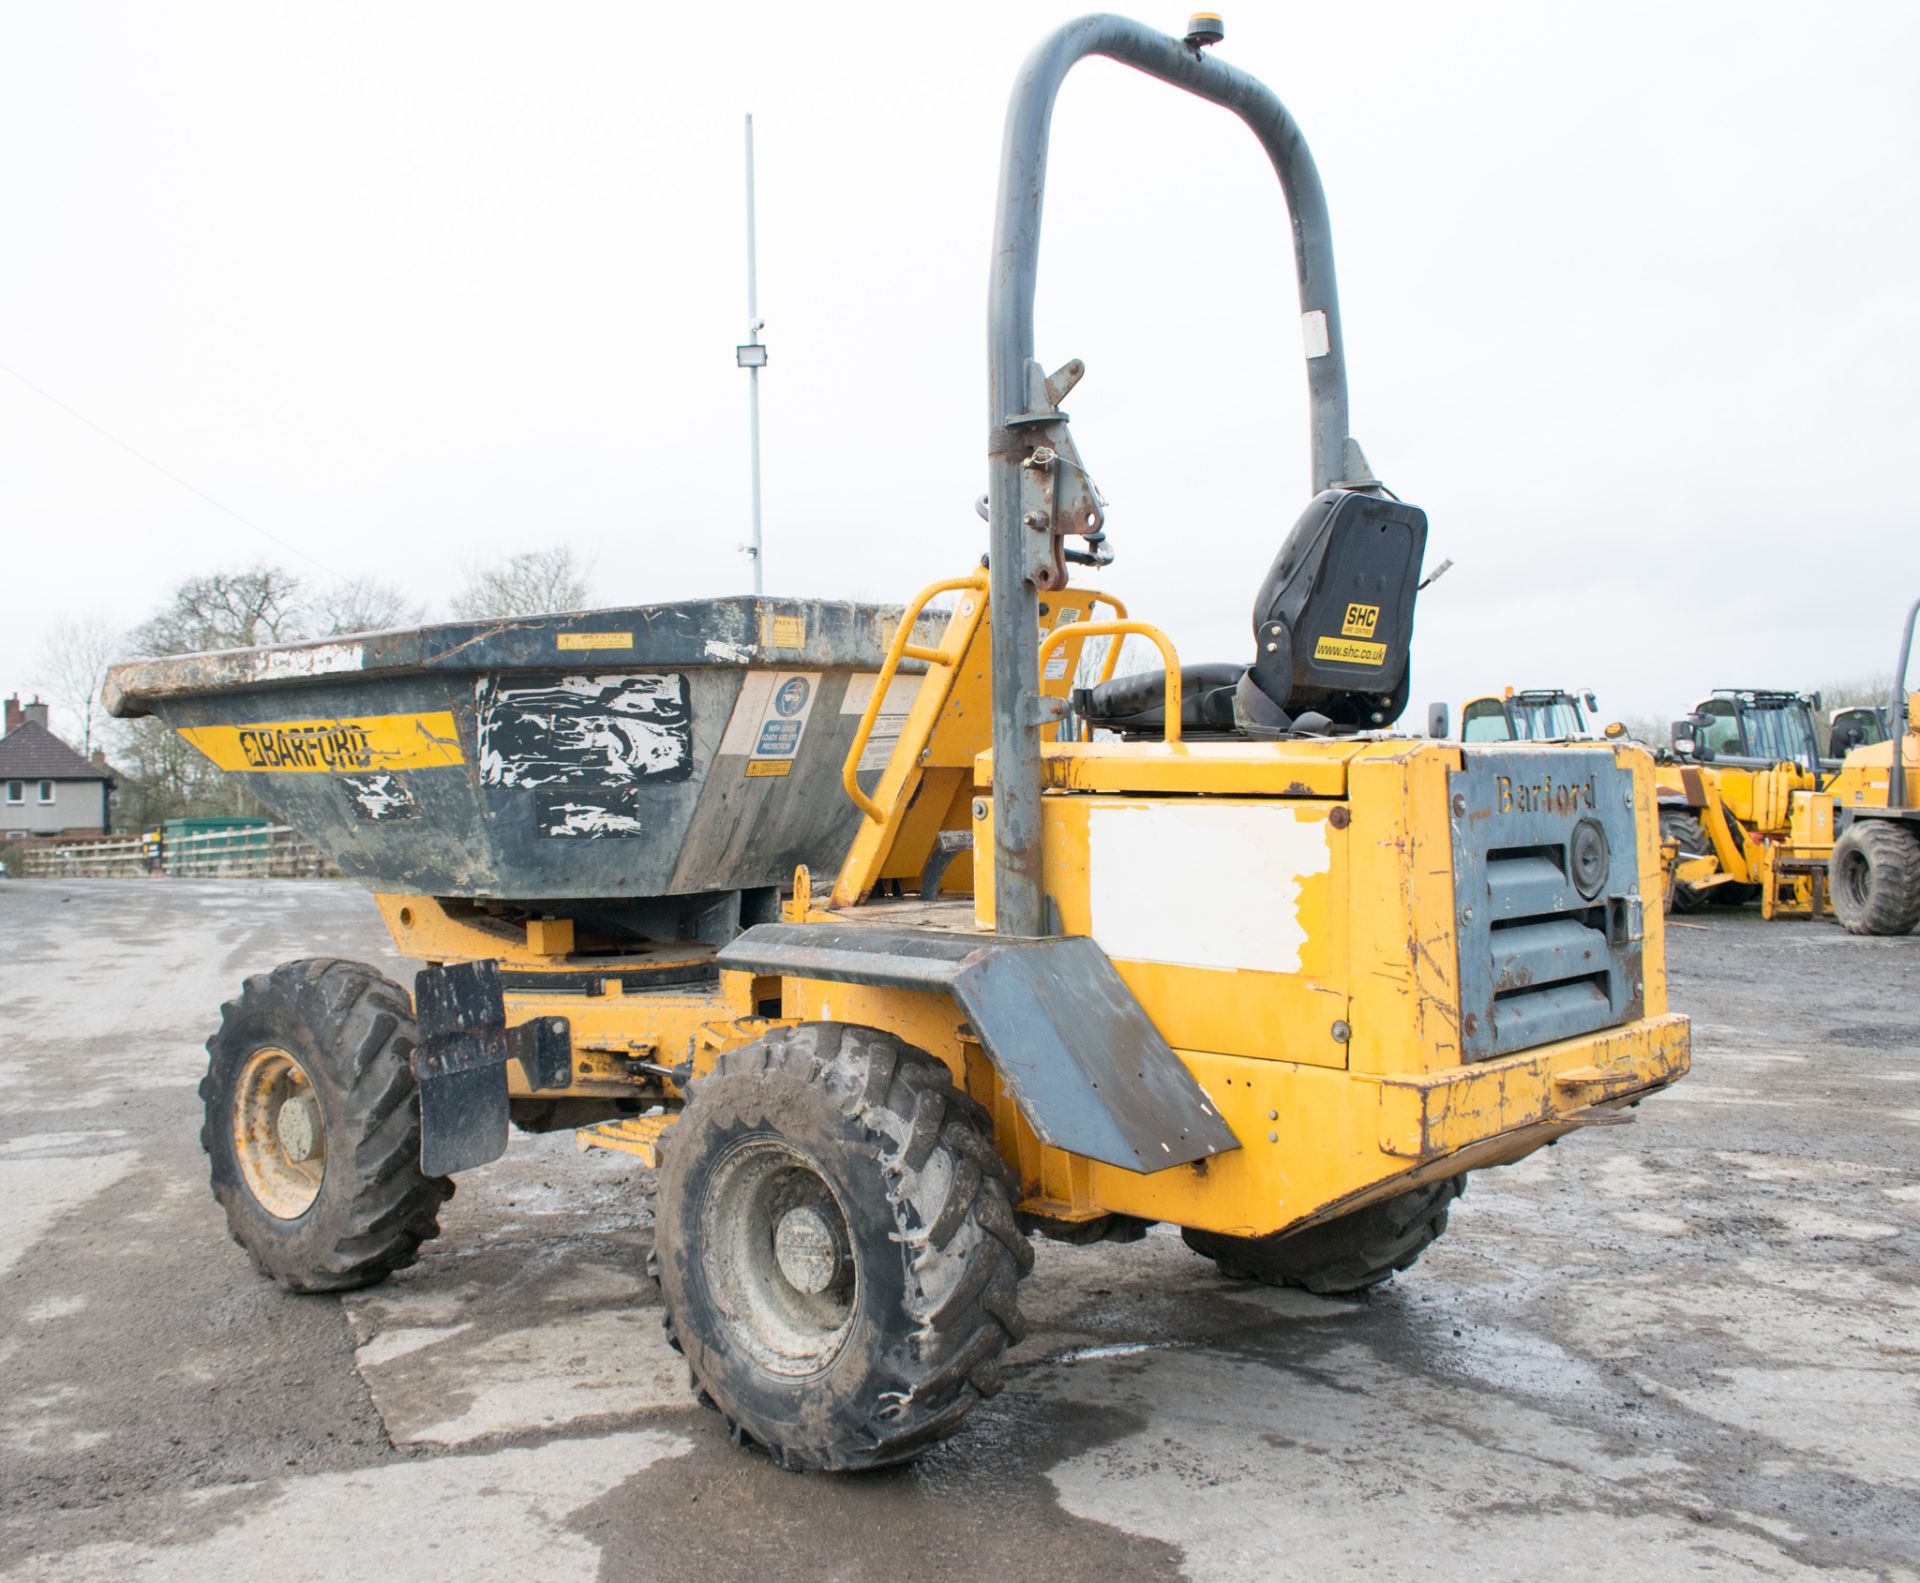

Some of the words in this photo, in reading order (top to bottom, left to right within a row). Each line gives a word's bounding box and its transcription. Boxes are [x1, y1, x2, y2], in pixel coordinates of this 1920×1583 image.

[1347, 606, 1376, 627] SHC
[1317, 645, 1384, 661] www.shc.co.uk
[258, 725, 371, 769] BARFORD
[1496, 774, 1596, 813] Barford
